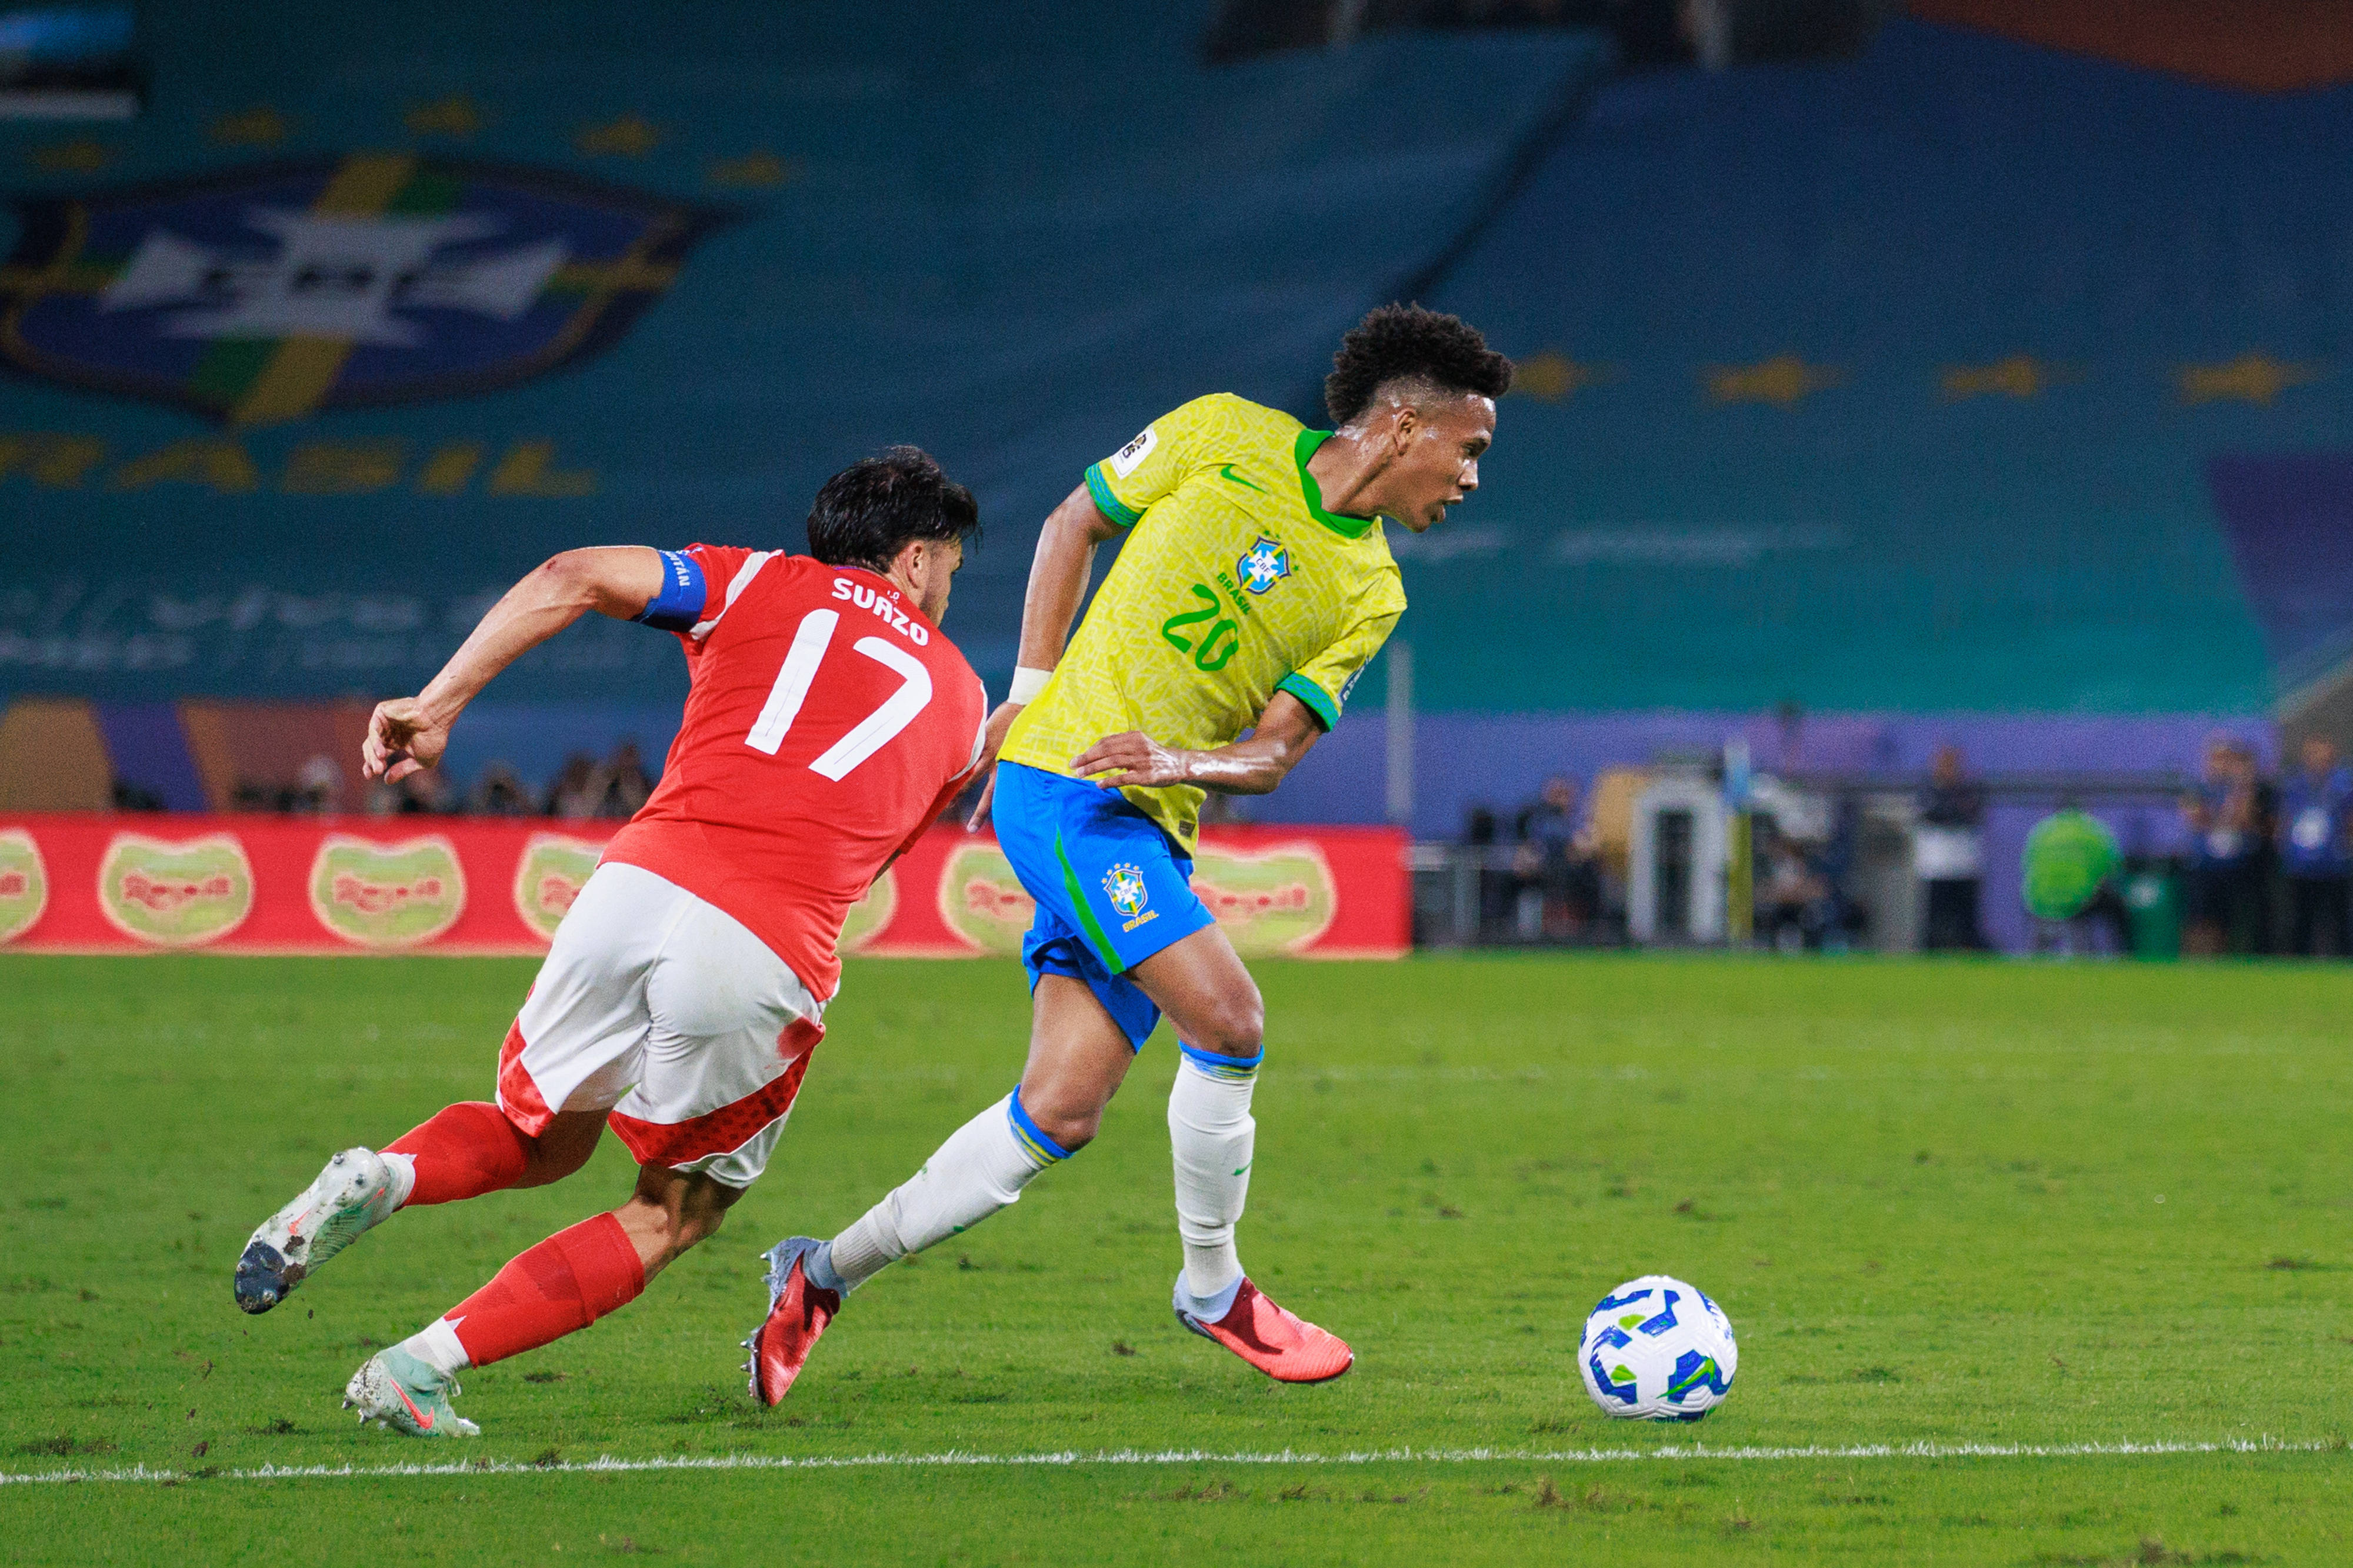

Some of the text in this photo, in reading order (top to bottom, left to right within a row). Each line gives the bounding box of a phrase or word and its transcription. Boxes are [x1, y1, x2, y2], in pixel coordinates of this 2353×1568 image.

[1255, 558, 1271, 573] CBF
[831, 578, 929, 646] SUAZO
[1217, 572, 1252, 615] BRASIL
[1162, 583, 1239, 671] 20
[744, 608, 933, 782] 17
[1122, 910, 1158, 933] BRASIL
